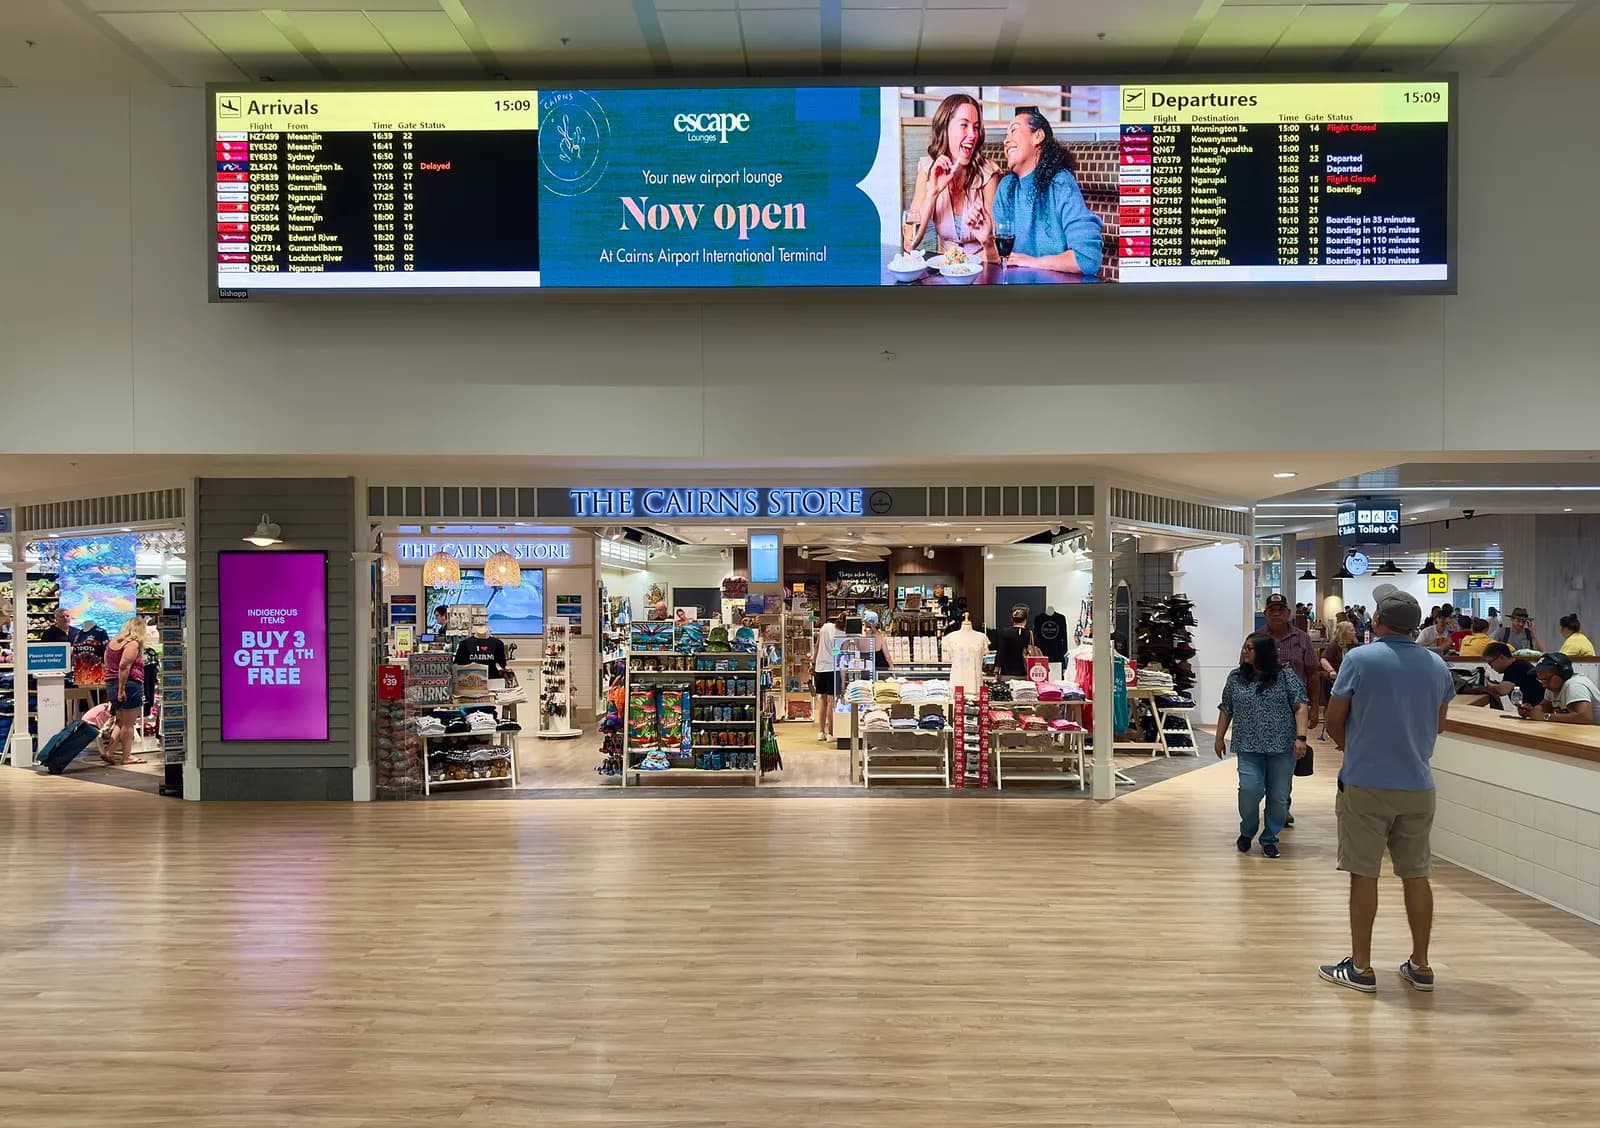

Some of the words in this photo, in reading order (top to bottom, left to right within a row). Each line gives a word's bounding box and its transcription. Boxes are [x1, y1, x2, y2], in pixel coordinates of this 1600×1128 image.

[1152, 93, 1257, 110] Departures
[1404, 93, 1440, 103] 15:09
[248, 100, 319, 115] Arrivals
[495, 100, 531, 111] 15:09
[1153, 114, 1176, 123] Flight
[1192, 114, 1239, 122] Destination
[1305, 114, 1324, 122] Gate
[1327, 113, 1353, 121] Status
[249, 122, 273, 130] Flight
[398, 122, 417, 130] Gate
[420, 121, 445, 129] Status
[674, 112, 750, 143] escape
[1278, 125, 1299, 133] 15:00
[1327, 124, 1352, 134] Flight
[1353, 124, 1376, 133] Closed
[373, 132, 393, 140] 16:39
[688, 133, 716, 143] Lounges
[1153, 135, 1175, 145] QN78
[1278, 135, 1299, 143] 15:00
[373, 142, 393, 150] 16:41
[1153, 145, 1175, 156] QN67
[1278, 145, 1299, 153] 15:00
[373, 153, 393, 161] 16:50
[1278, 155, 1299, 163] 15:02
[1327, 155, 1362, 165] Departed
[373, 163, 393, 171] 17:00
[420, 162, 450, 172] Delayed
[1152, 166, 1183, 174] NZ7317
[1278, 165, 1299, 173] 15:02
[1327, 165, 1362, 175] Departed
[373, 173, 393, 181] 17:15
[642, 170, 669, 184] Your
[673, 174, 696, 183] new
[700, 170, 740, 187] airport
[743, 169, 782, 187] lounge
[1278, 175, 1299, 184] 15:05
[1327, 175, 1352, 185] Flight
[1353, 175, 1376, 183] Closed
[373, 183, 393, 191] 17:24
[1278, 186, 1299, 194] 15:20
[1327, 185, 1361, 196] Boarding
[373, 193, 393, 201] 17:25
[1152, 196, 1183, 205] NZ7187
[1278, 196, 1299, 204] 15:35
[374, 203, 394, 211] 17:30
[1278, 206, 1299, 214] 15:35
[374, 213, 394, 221] 18:00
[620, 196, 705, 230] Now
[714, 203, 806, 240] open
[1278, 216, 1299, 224] 16:10
[1326, 216, 1361, 226] Boarding
[1363, 216, 1370, 224] in
[1373, 216, 1382, 224] 35
[1384, 216, 1415, 224] minutes
[374, 223, 394, 231] 18:15
[1278, 226, 1299, 235] 17:20
[1326, 226, 1361, 236] Boarding
[1363, 226, 1370, 234] in
[1373, 226, 1386, 234] 105
[1389, 226, 1419, 234] minutes
[251, 234, 273, 244] QN78
[374, 233, 394, 241] 18:20
[1278, 237, 1299, 245] 17:25
[1326, 236, 1361, 246] Boarding
[1363, 236, 1370, 244] in
[1373, 236, 1386, 244] 110
[1389, 236, 1419, 244] minutes
[251, 244, 281, 252] NZ7314
[374, 244, 394, 252] 18:25
[1278, 247, 1299, 255] 17:30
[1326, 246, 1361, 257] Boarding
[1363, 246, 1370, 255] in
[1373, 246, 1386, 255] 115
[1389, 246, 1419, 255] minutes
[251, 254, 273, 264] QN54
[374, 254, 394, 262] 18:40
[600, 249, 613, 262] At
[617, 249, 653, 262] Cairns
[658, 249, 699, 266] Airport
[703, 247, 775, 262] International
[779, 246, 826, 262] Terminal
[1278, 257, 1299, 265] 17:45
[1326, 257, 1361, 267] Boarding
[1363, 257, 1370, 265] in
[1373, 257, 1386, 265] 130
[1389, 257, 1419, 265] minutes
[374, 264, 394, 272] 19:10
[220, 290, 246, 298] bishopp
[571, 491, 632, 514] THE
[644, 490, 757, 514] CAIRNS
[768, 490, 861, 514] STORE
[1358, 525, 1387, 533] Toilets
[441, 544, 508, 558] CAIRNS
[514, 544, 569, 558] STORE
[1431, 578, 1445, 588] 18
[242, 632, 288, 648] BUY
[294, 631, 305, 648] 3
[234, 650, 278, 666] GET
[283, 649, 313, 666] 4TH
[412, 664, 450, 674] CAIRNS
[248, 669, 300, 684] FREE
